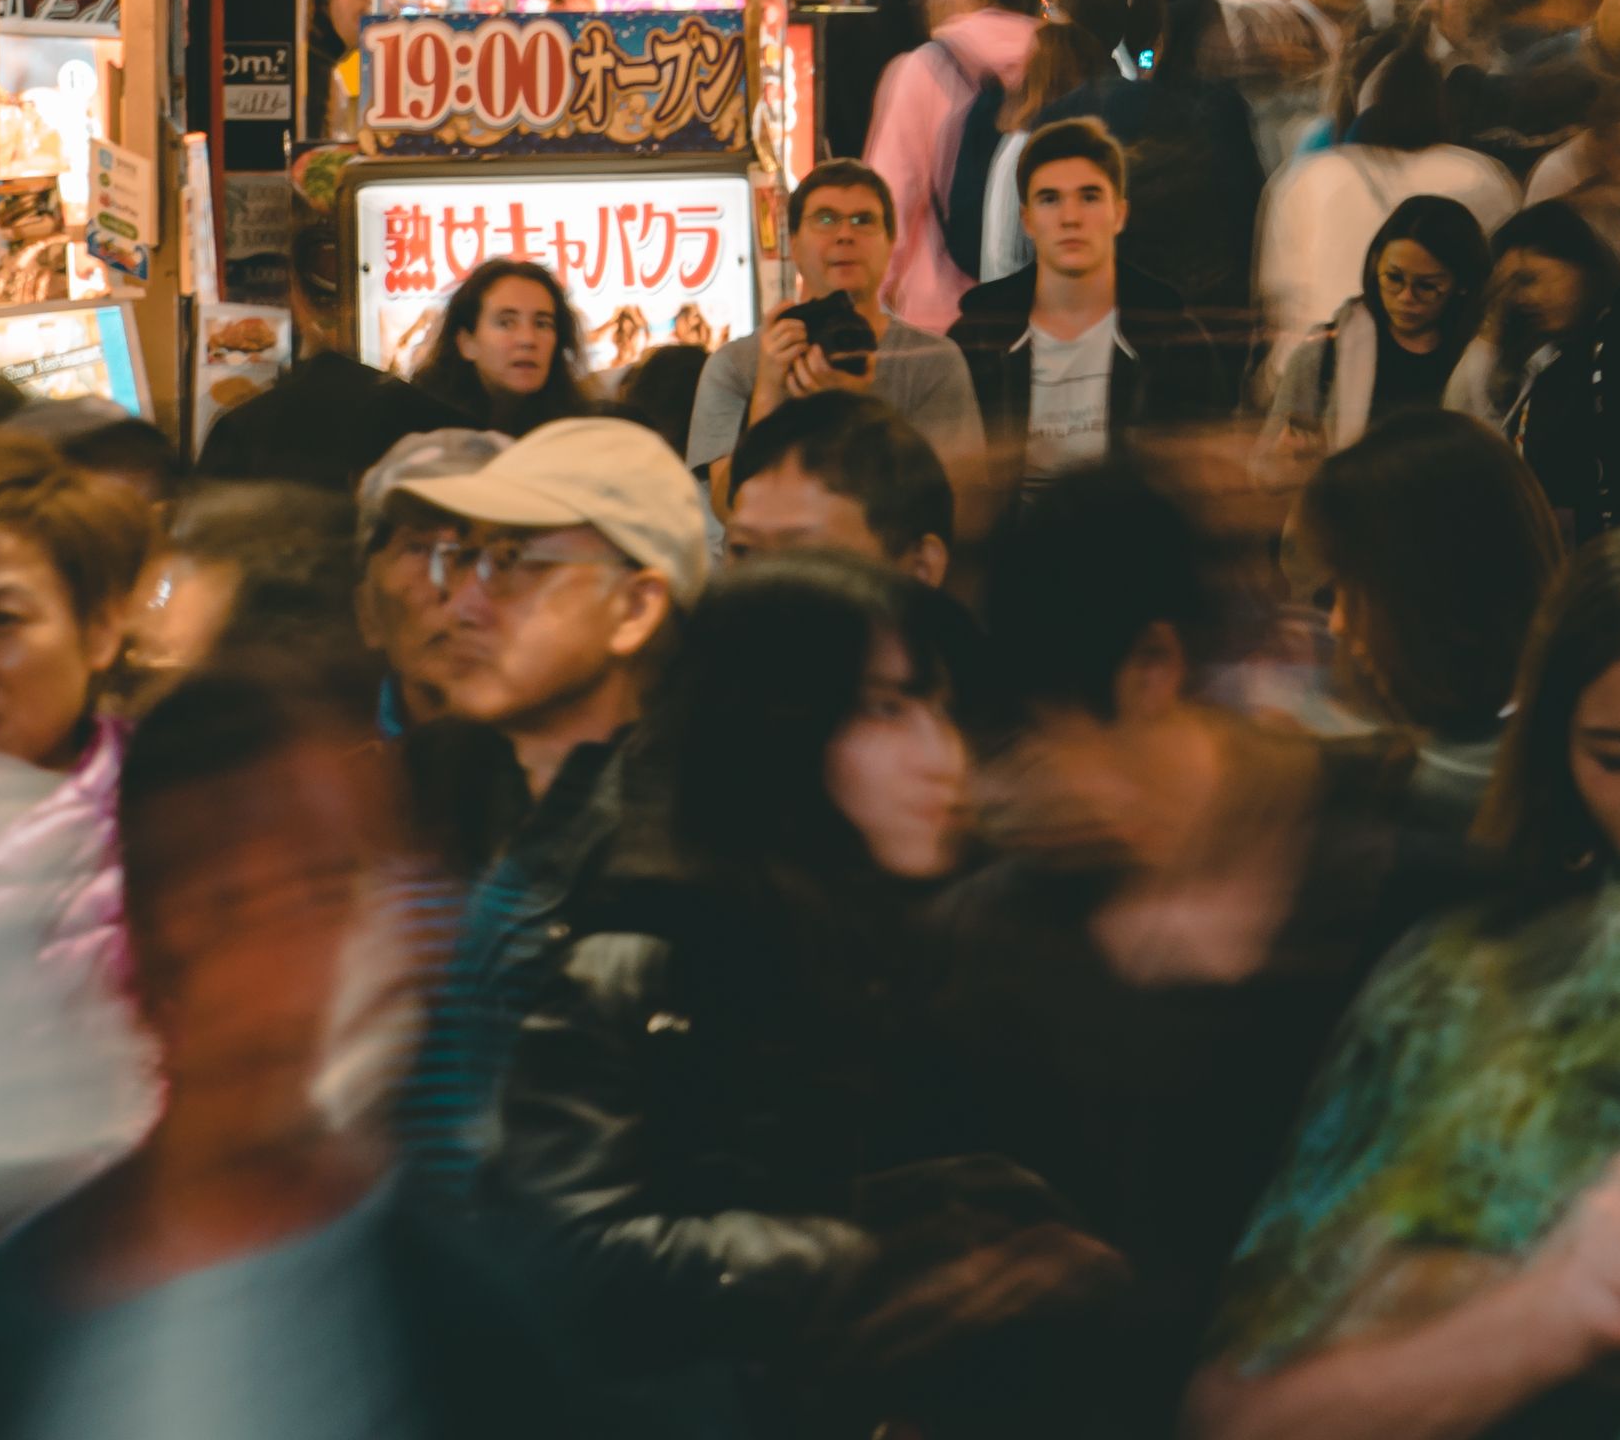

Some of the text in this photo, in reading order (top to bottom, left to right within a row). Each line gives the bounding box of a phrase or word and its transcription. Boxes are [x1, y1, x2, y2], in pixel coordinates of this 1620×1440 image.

[370, 15, 747, 131] 19:00 オープン
[382, 200, 727, 296] 熟女キャバクラ
